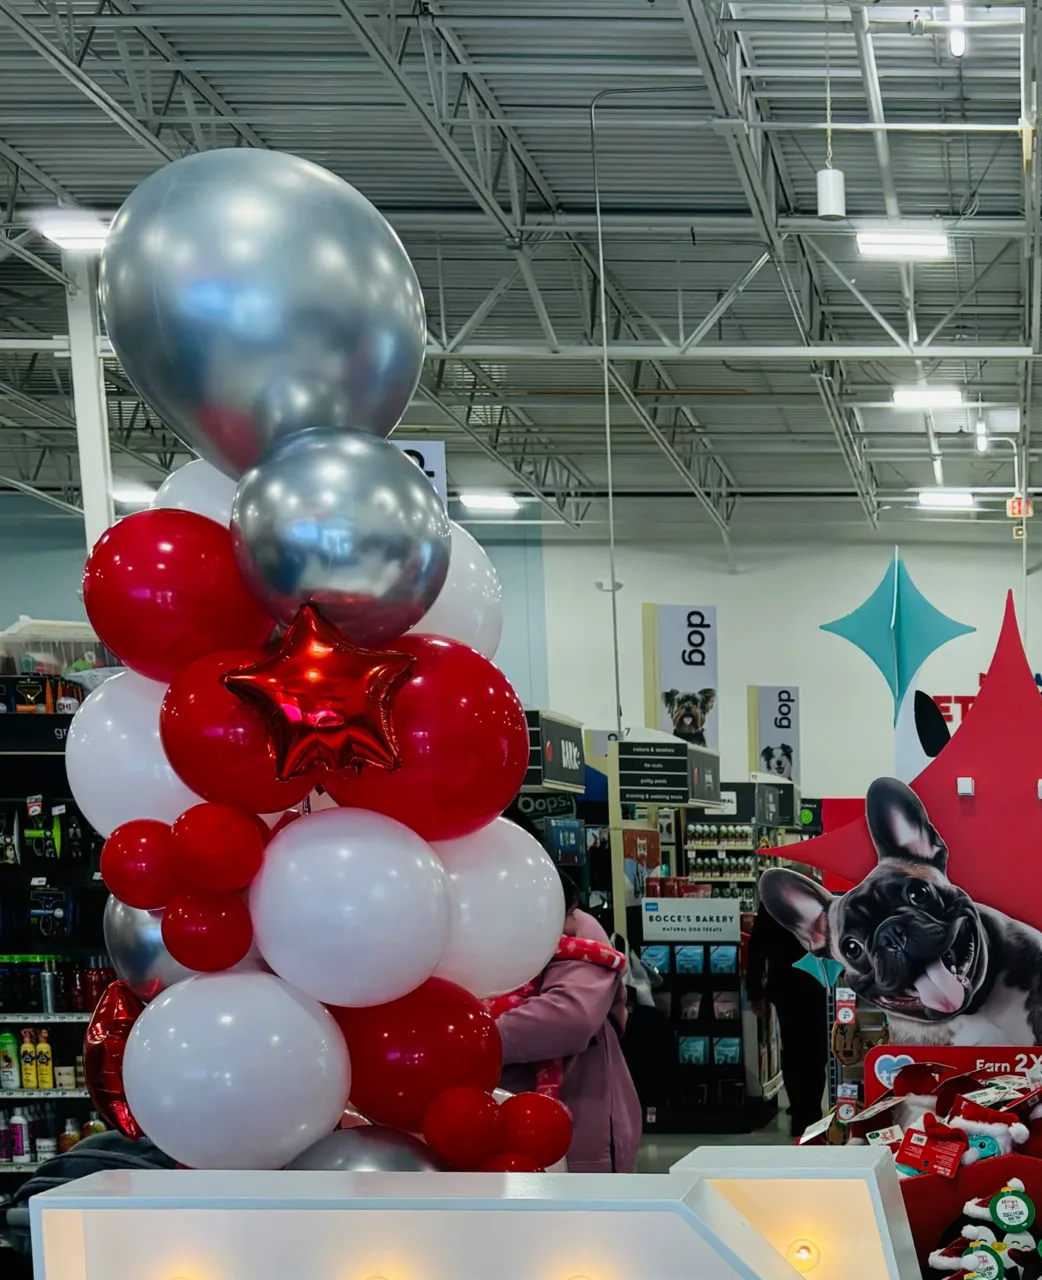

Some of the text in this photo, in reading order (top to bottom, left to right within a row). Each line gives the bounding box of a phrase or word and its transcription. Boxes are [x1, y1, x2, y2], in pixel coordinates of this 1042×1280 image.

[681, 610, 711, 666] dog
[774, 689, 795, 729] dog
[625, 727, 631, 737] 7
[648, 915, 735, 923] BOCCE'S BAKERY
[976, 1059, 1011, 1073] Earn
